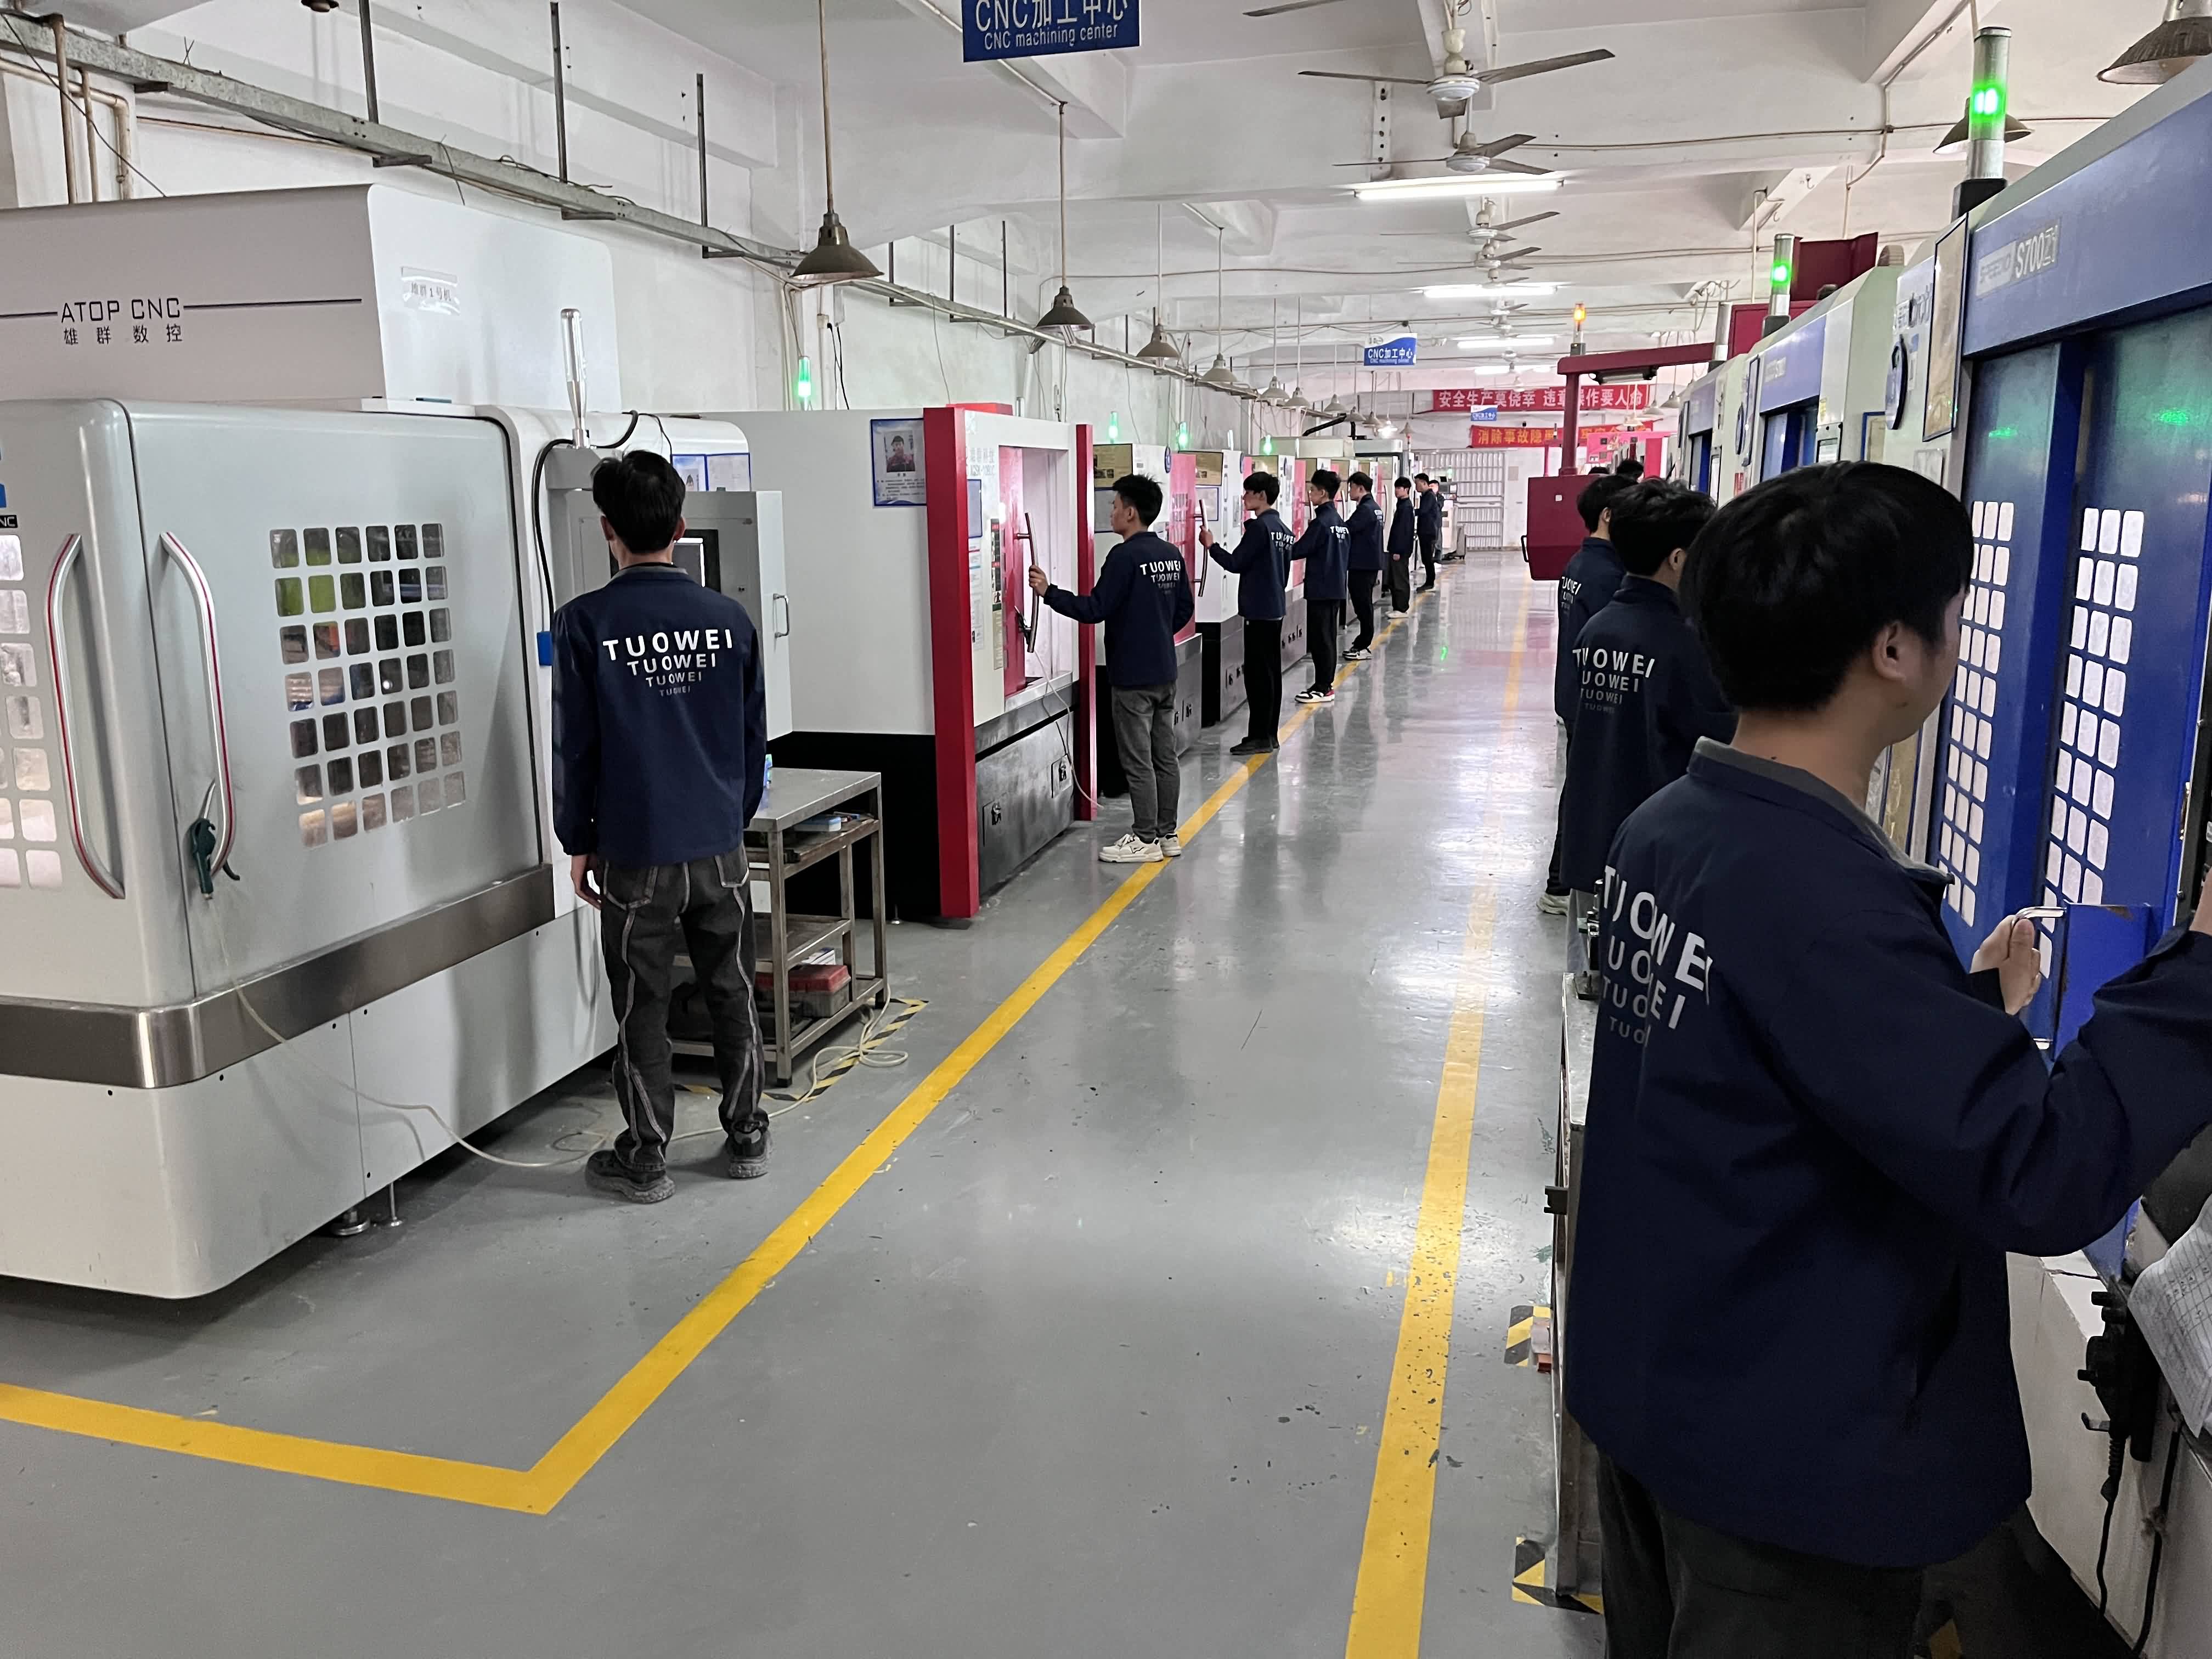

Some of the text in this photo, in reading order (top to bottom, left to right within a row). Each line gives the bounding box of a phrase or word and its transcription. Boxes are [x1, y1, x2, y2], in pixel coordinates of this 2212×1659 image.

[984, 23, 1118, 50] CNC machining center
[61, 297, 180, 323] ATOP CNC
[63, 323, 183, 346] 雄群数控
[1368, 347, 1413, 359] CNC加工中心
[1439, 390, 1536, 408] 安全生产莫侥幸
[1139, 560, 1181, 575] TUOWEI
[602, 629, 732, 661] TUOWEI
[627, 653, 716, 676] TUOWEI
[1572, 647, 1655, 678] TUOWEI
[646, 671, 702, 687] TUOWEI
